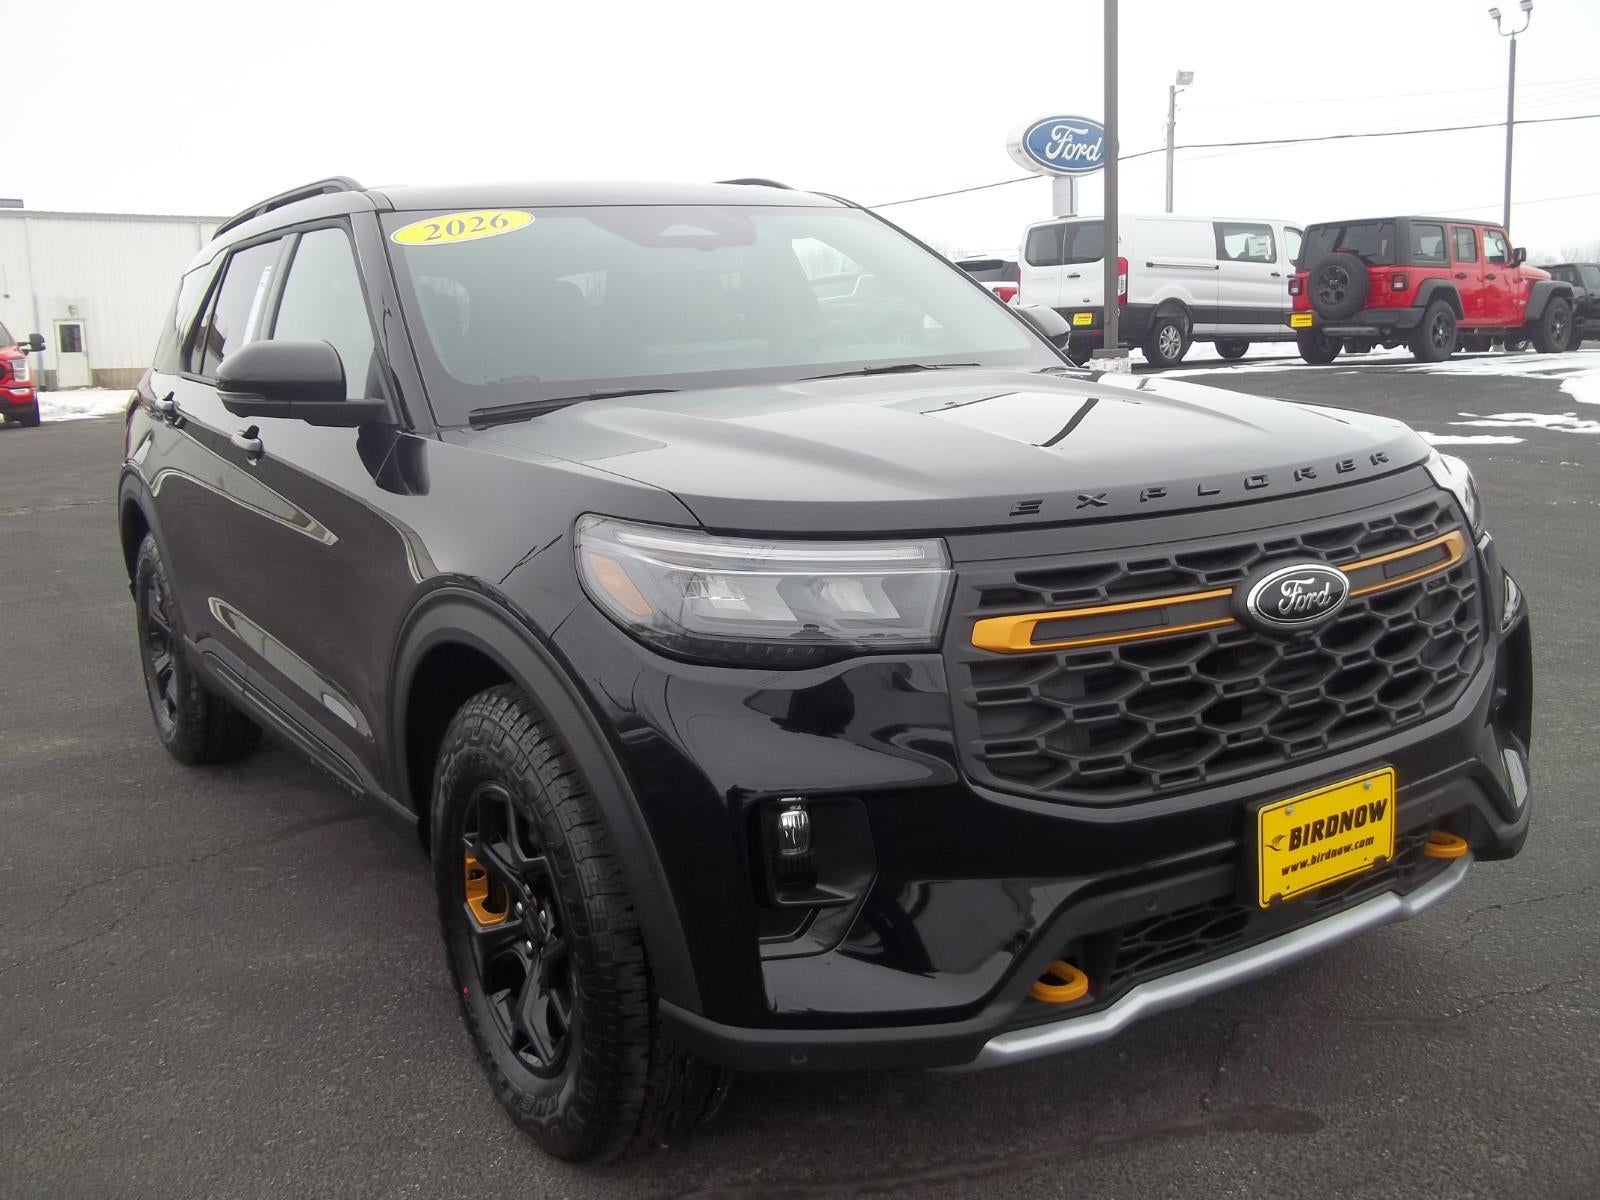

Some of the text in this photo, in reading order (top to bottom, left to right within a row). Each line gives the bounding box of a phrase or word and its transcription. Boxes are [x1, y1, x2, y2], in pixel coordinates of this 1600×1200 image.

[1045, 125, 1102, 161] Ford
[423, 213, 508, 241] 2026
[1009, 451, 1390, 517] EXPLORER
[1278, 577, 1331, 615] Ford
[1288, 798, 1388, 852] BIRDNOW
[1281, 836, 1375, 876] www.birdnow.com
